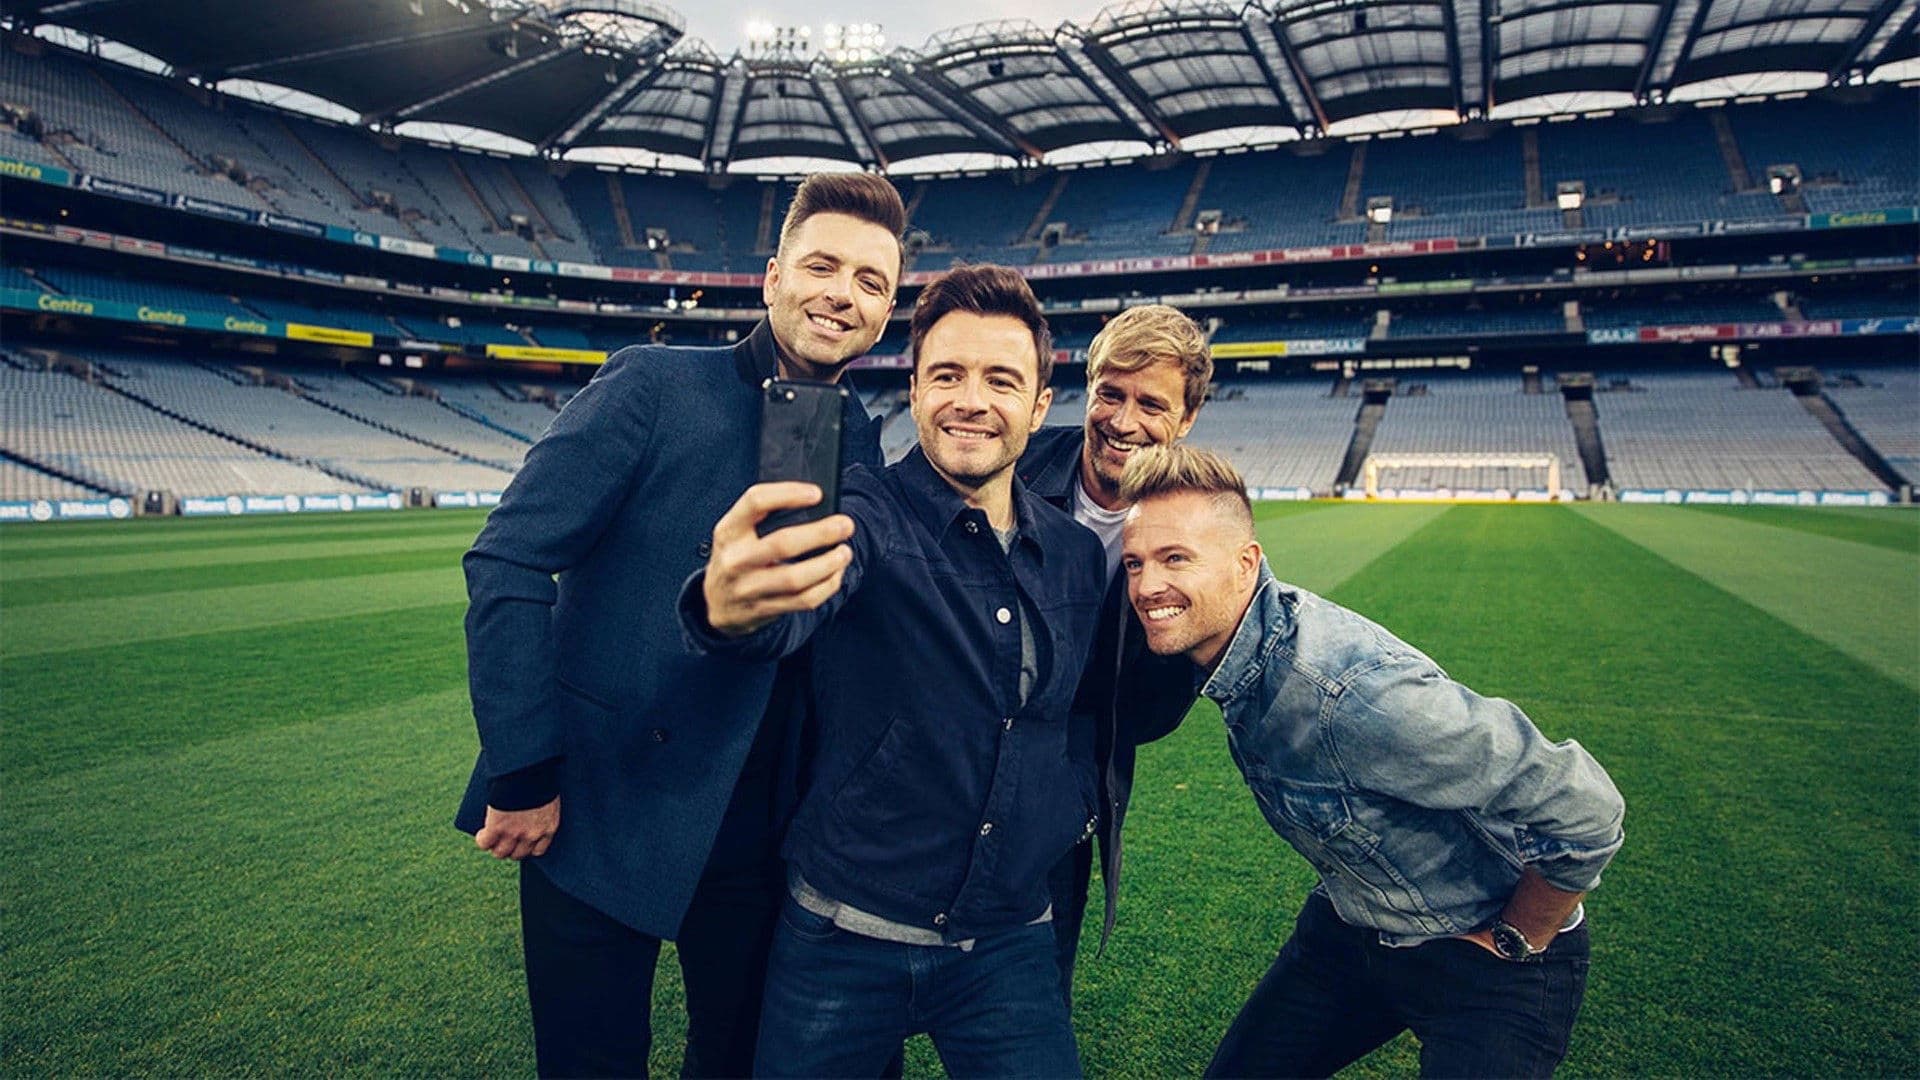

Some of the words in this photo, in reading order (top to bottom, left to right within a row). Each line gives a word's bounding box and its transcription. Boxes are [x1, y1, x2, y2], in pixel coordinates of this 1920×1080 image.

[1829, 212, 1887, 226] Centra
[39, 295, 93, 314] Centra
[138, 306, 186, 325] Centra
[225, 317, 267, 334] Centra
